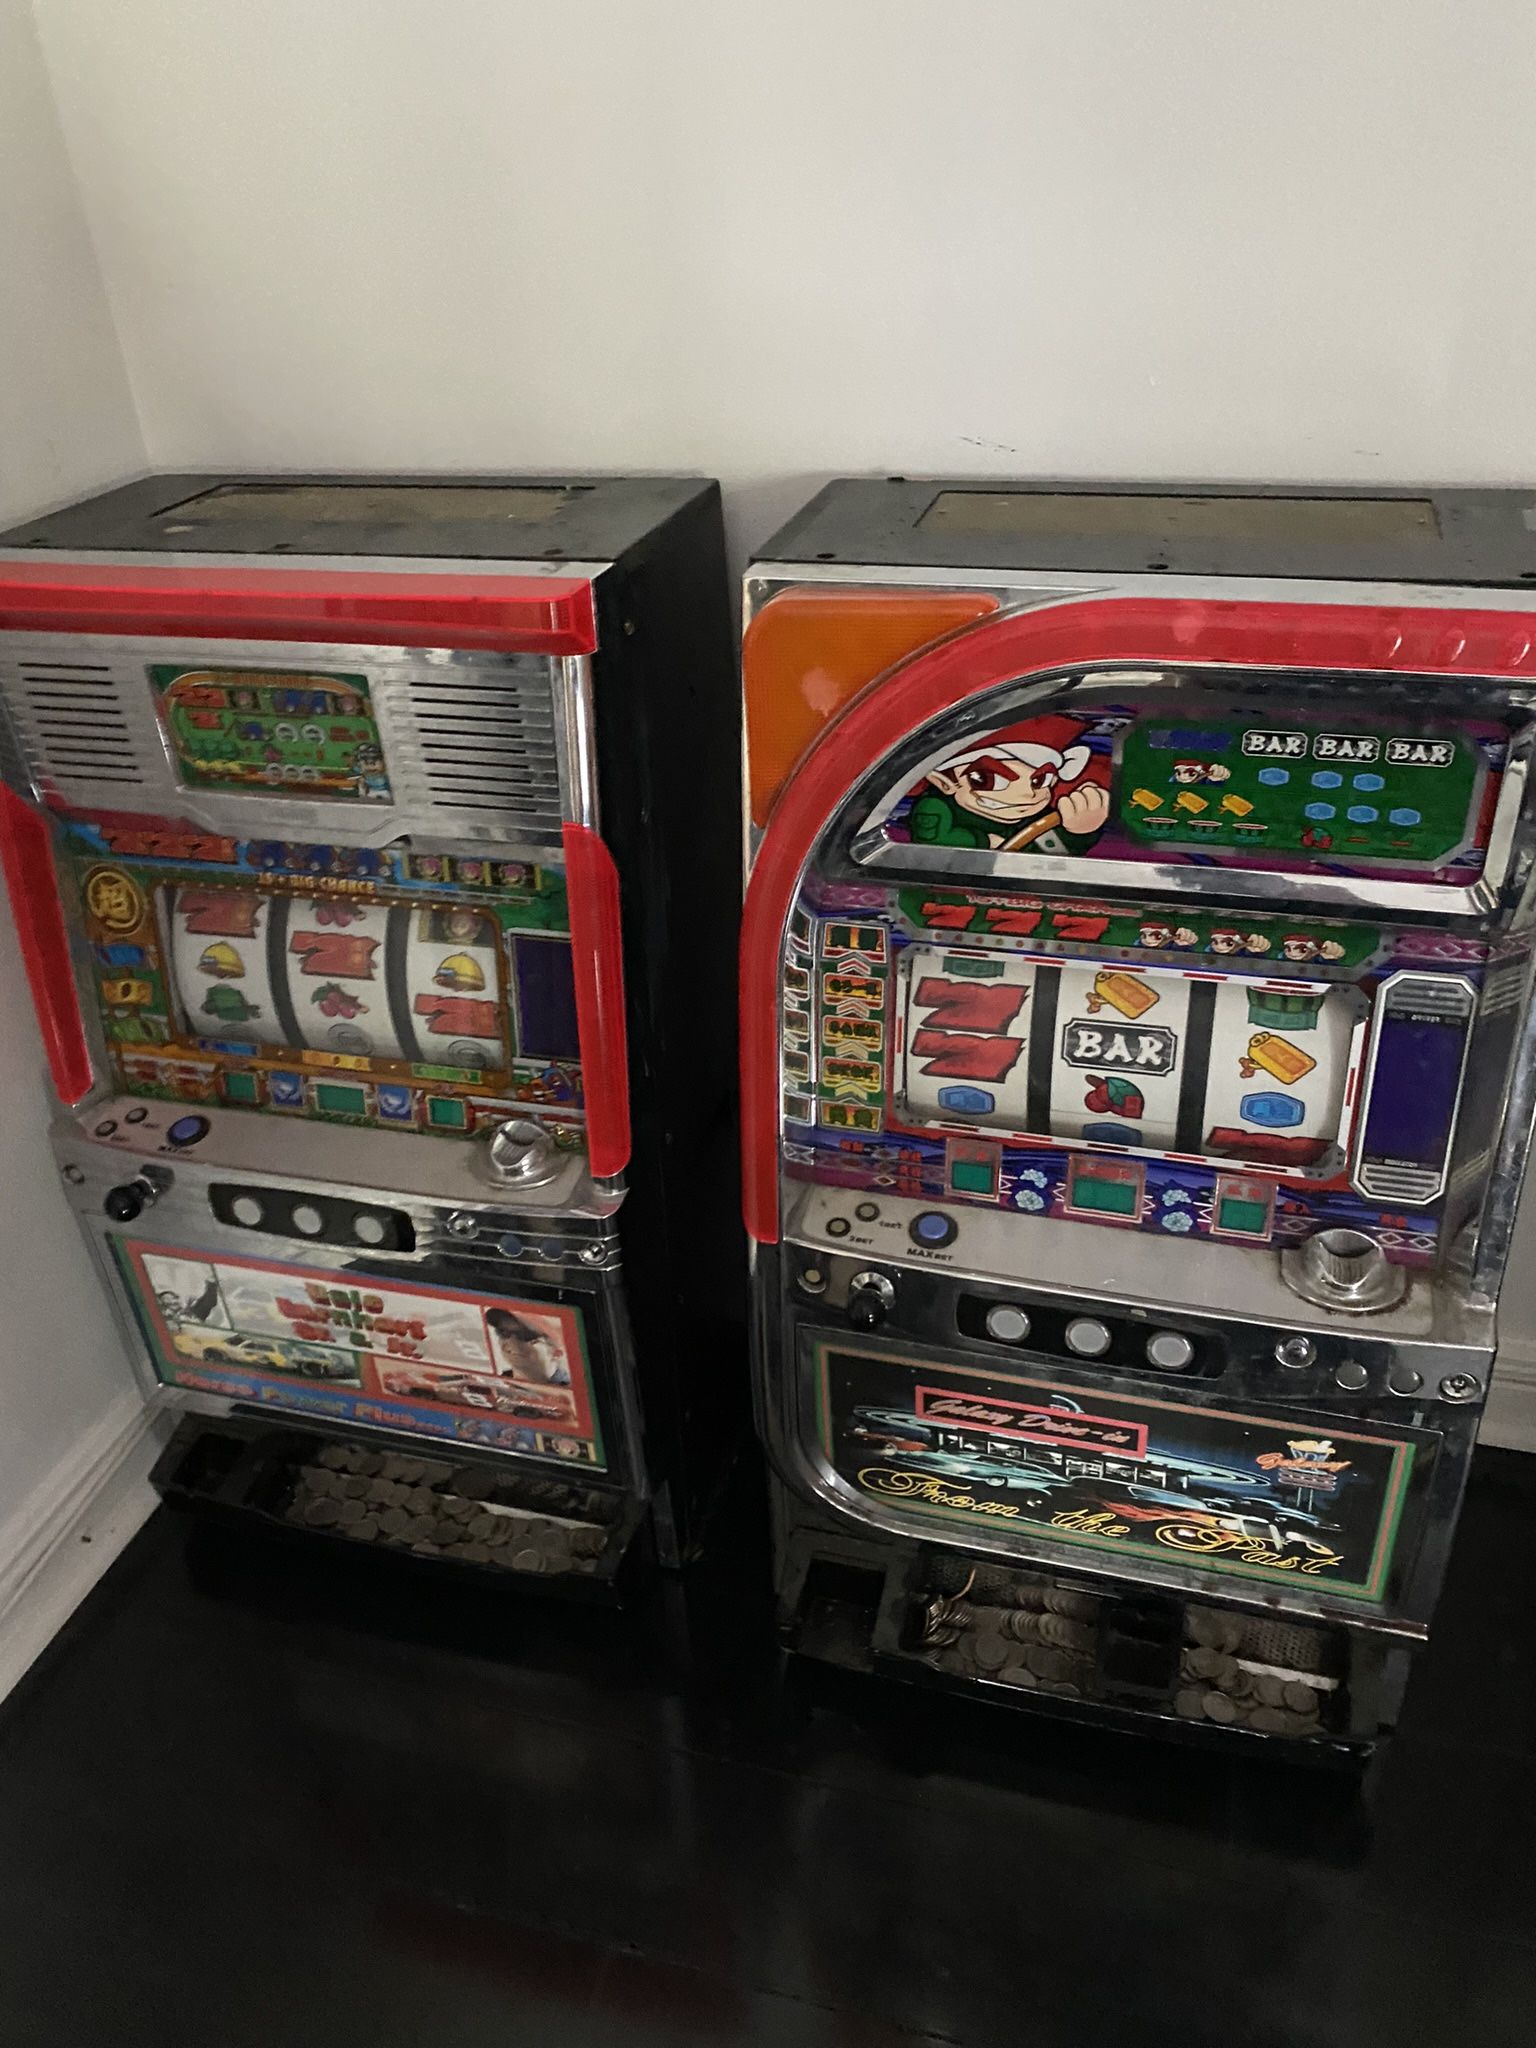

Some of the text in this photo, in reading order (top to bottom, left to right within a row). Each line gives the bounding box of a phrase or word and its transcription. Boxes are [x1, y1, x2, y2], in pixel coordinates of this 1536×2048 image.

[1248, 733, 1449, 764] BAR BAR BAR
[318, 876, 376, 896] CHANCE
[1072, 1028, 1165, 1066] BAR
[907, 1247, 935, 1258] MAX
[304, 1281, 384, 1314] Dale
[1050, 1508, 1131, 1538] the
[1155, 1516, 1345, 1575] Past
